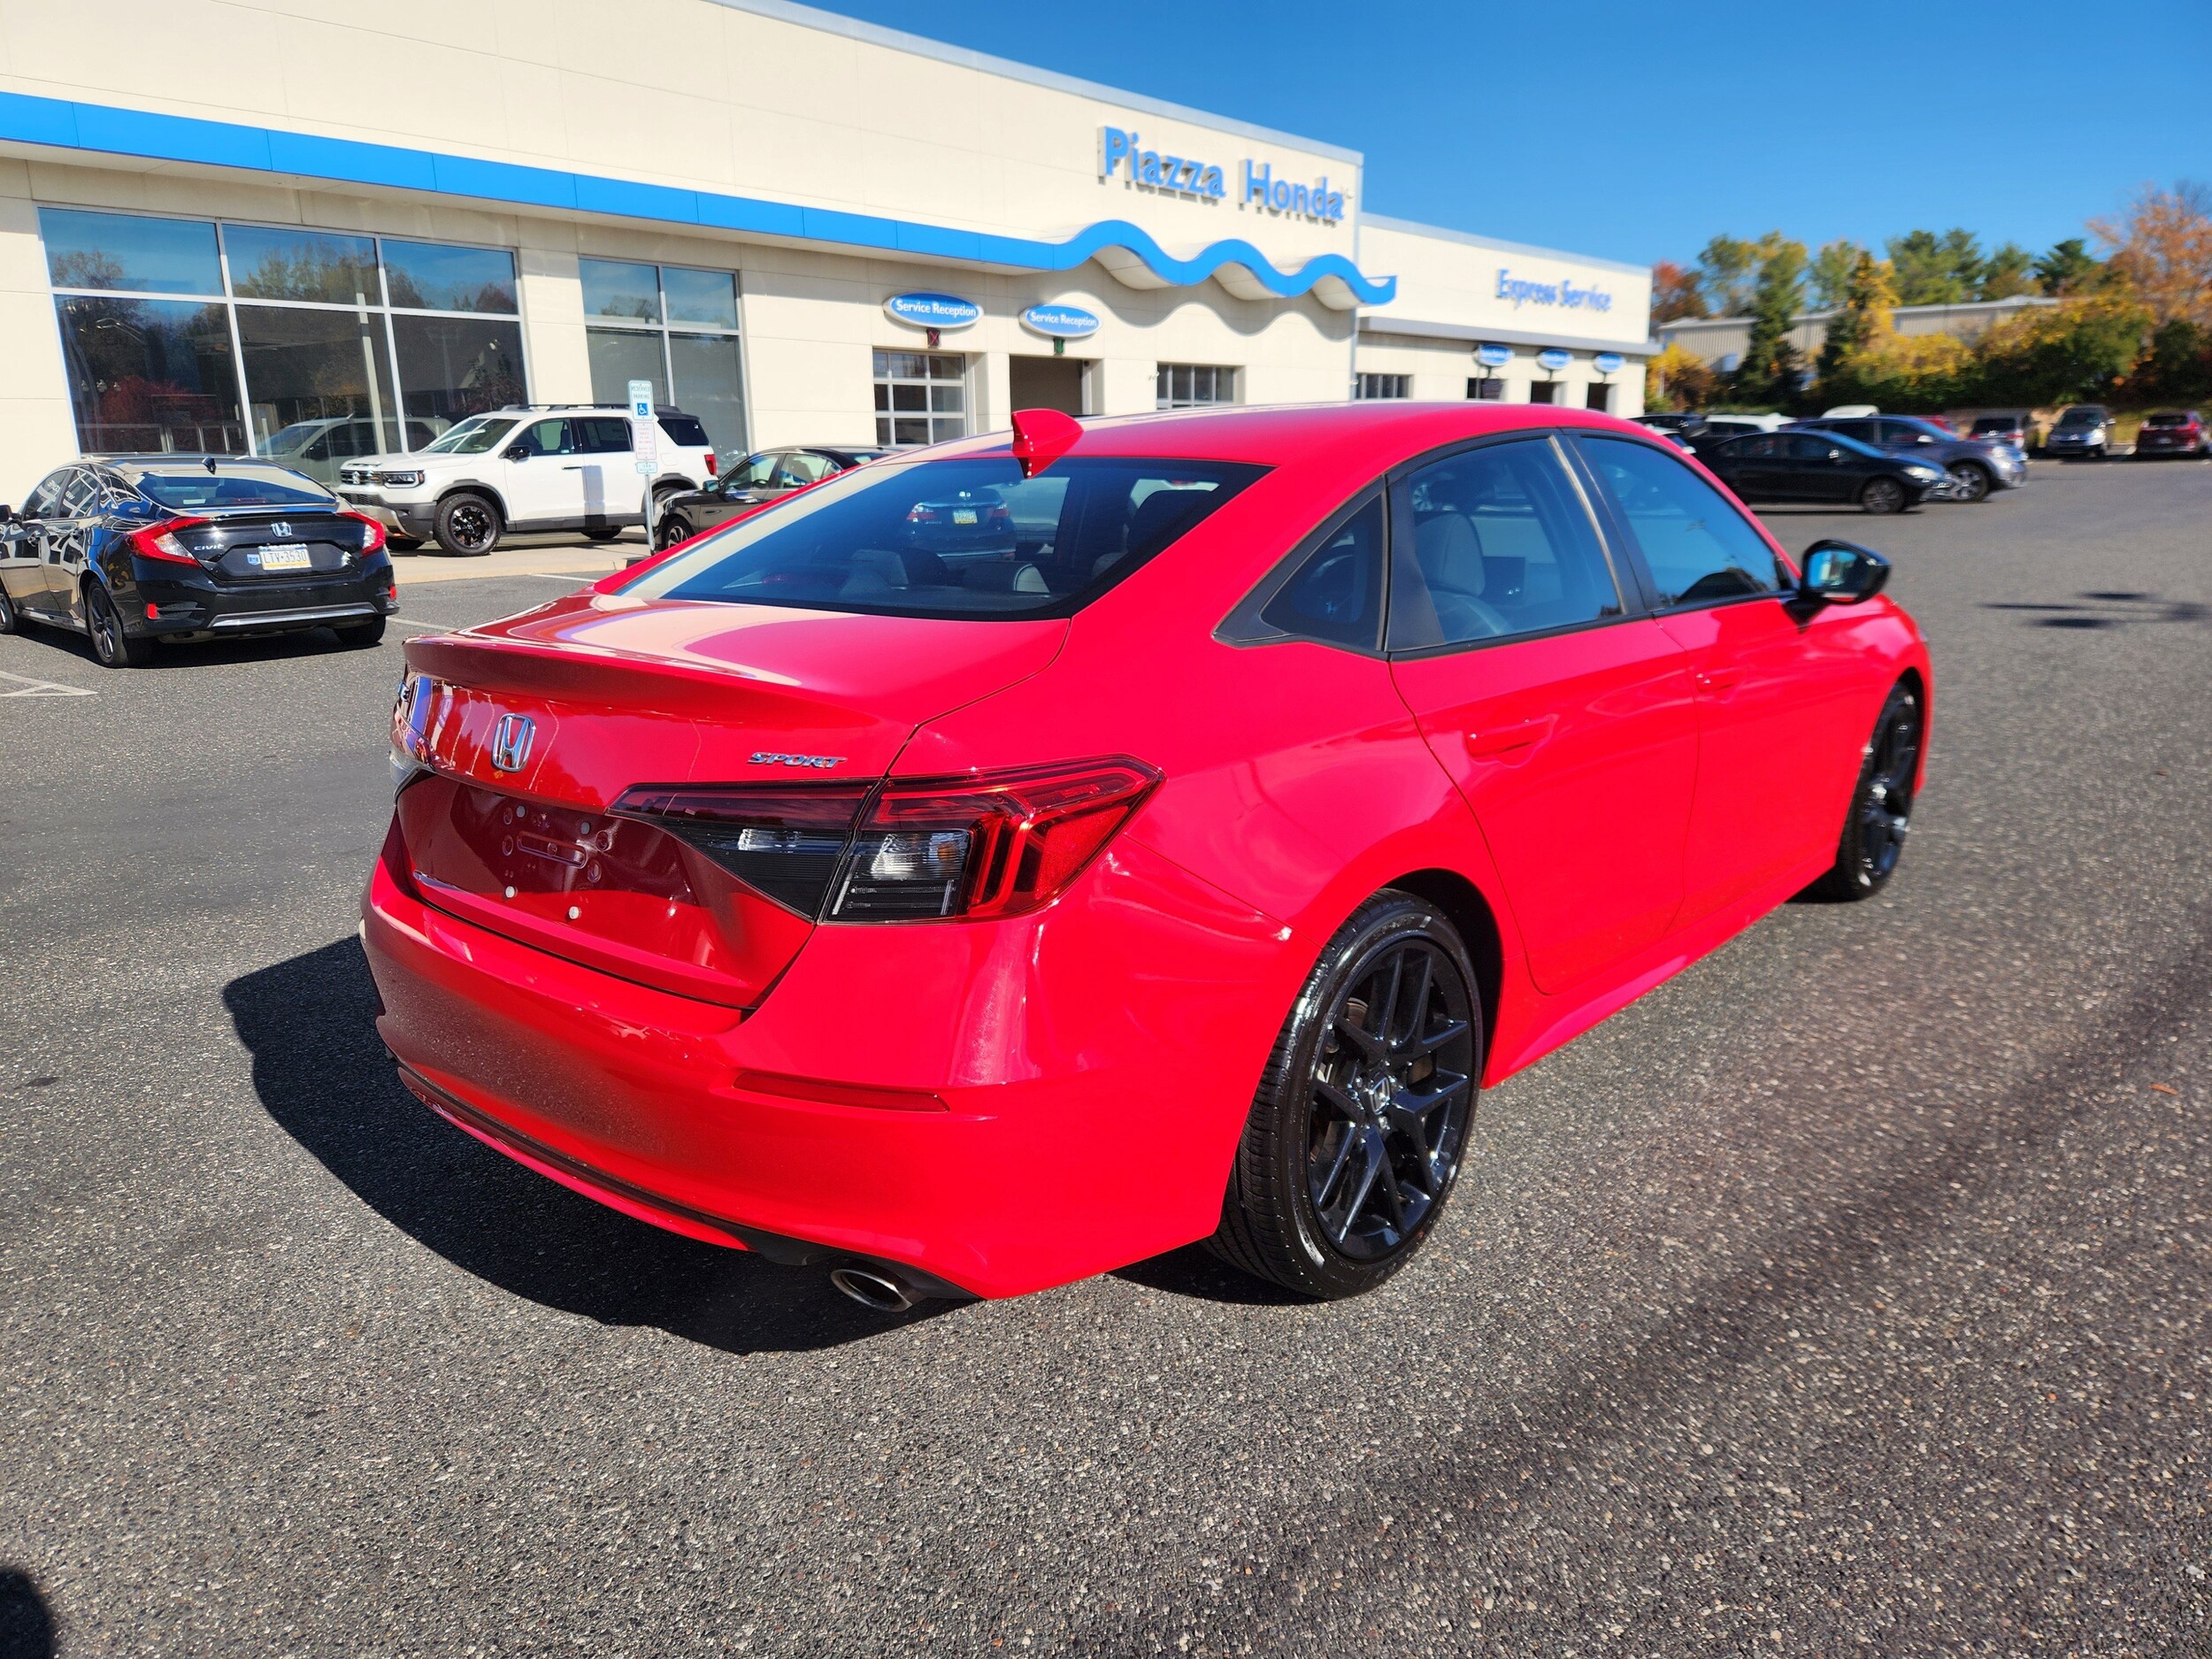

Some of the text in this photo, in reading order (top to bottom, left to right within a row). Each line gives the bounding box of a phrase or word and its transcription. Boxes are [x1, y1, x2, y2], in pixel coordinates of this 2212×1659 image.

[1103, 126, 1345, 221] Piazza Honda
[1498, 268, 1612, 311] Express Service
[896, 296, 977, 319] Service Reception
[1030, 311, 1097, 328] Service Reception
[748, 751, 848, 768] SPORT
